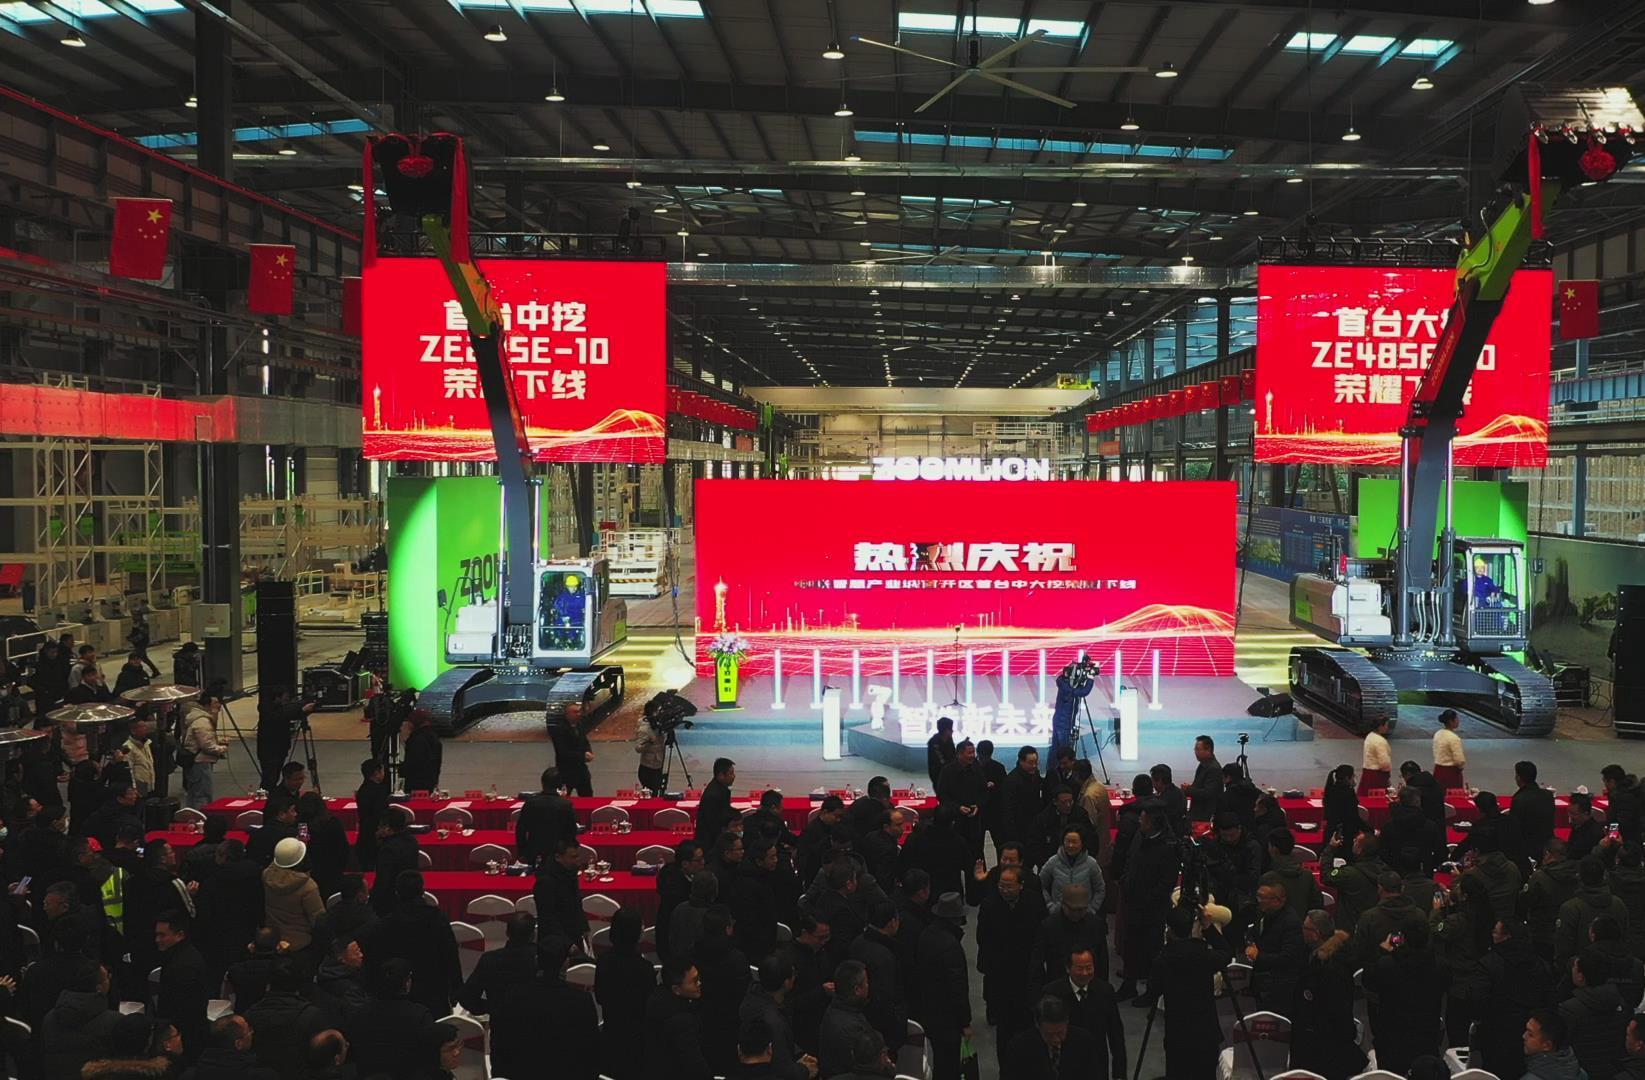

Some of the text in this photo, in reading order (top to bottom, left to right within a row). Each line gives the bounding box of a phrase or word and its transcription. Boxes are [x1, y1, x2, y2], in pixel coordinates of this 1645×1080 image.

[1335, 307, 1450, 338] 首台大
[419, 335, 609, 365] ZE5E-10
[1311, 341, 1496, 370] ZE485E0
[443, 368, 587, 400] 荣下线
[1334, 373, 1472, 406] 荣耀
[873, 458, 1050, 481] ZOOMLION
[854, 541, 1076, 572] 热烈庆祝
